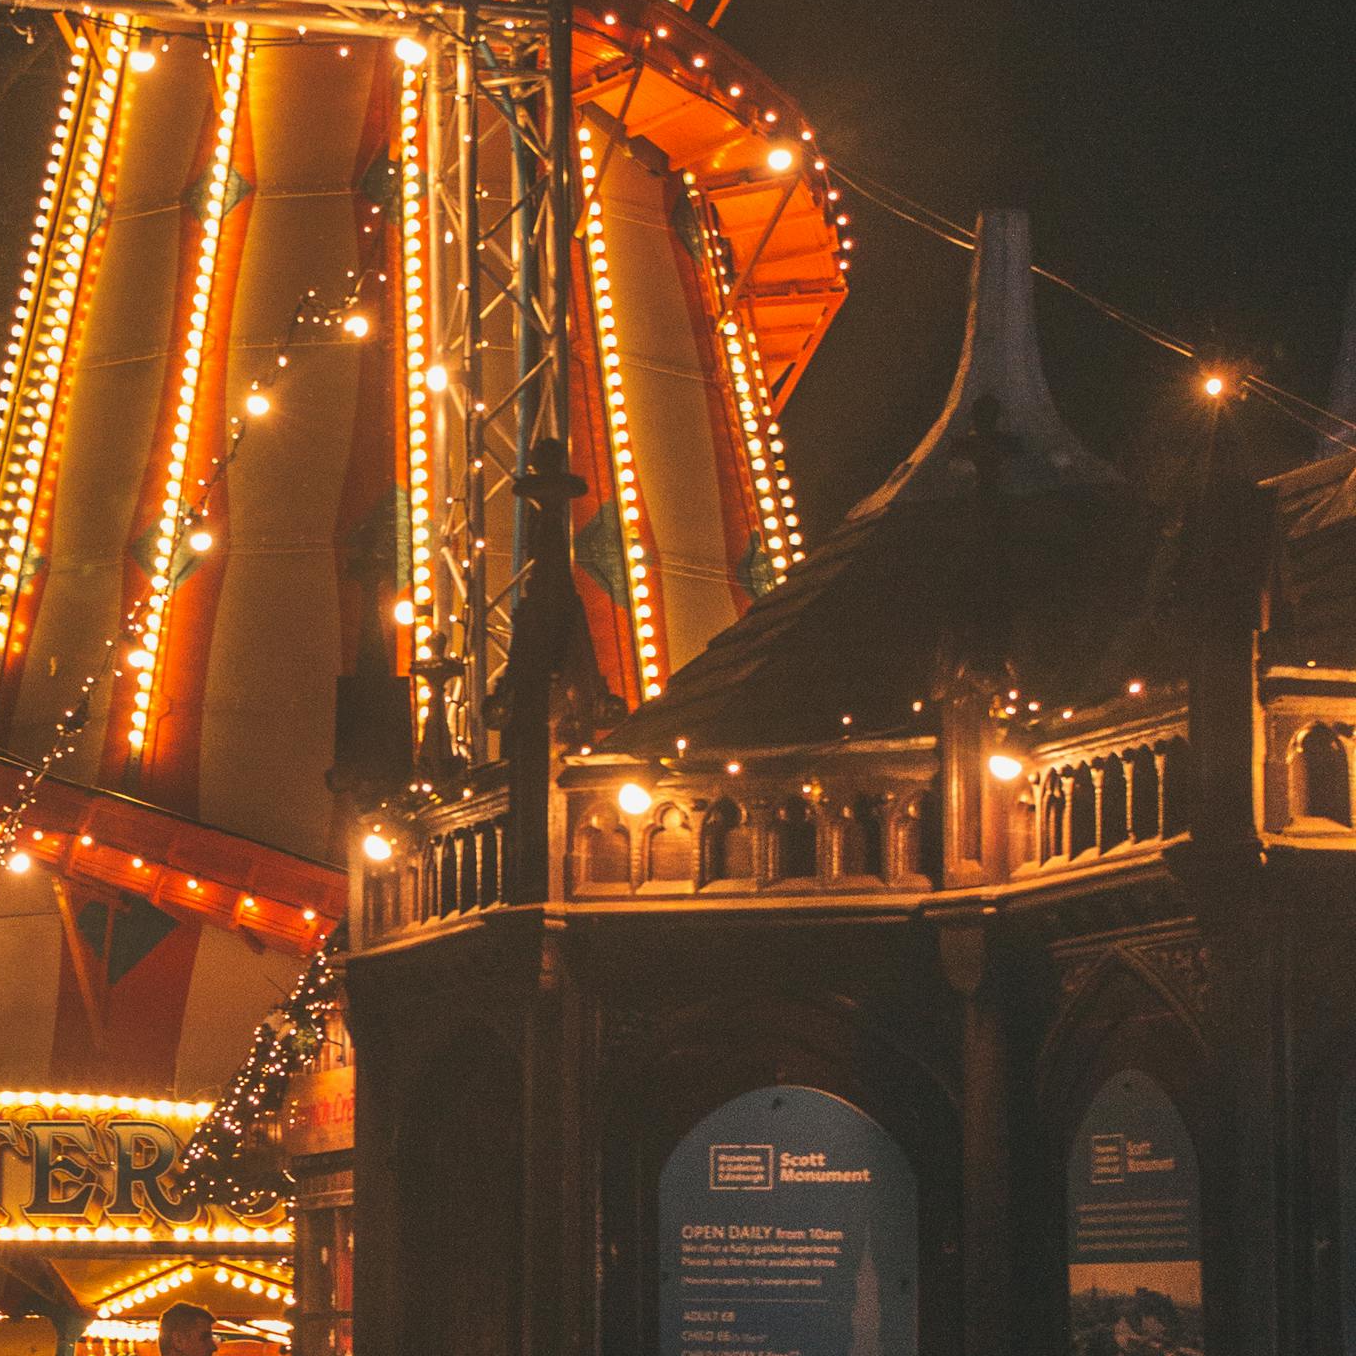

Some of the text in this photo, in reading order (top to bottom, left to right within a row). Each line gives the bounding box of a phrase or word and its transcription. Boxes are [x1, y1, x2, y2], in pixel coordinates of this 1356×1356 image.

[780, 1152, 826, 1167] Scott
[780, 1168, 871, 1183] Monument
[681, 1225, 844, 1241] OPEN DAILY from 10am
